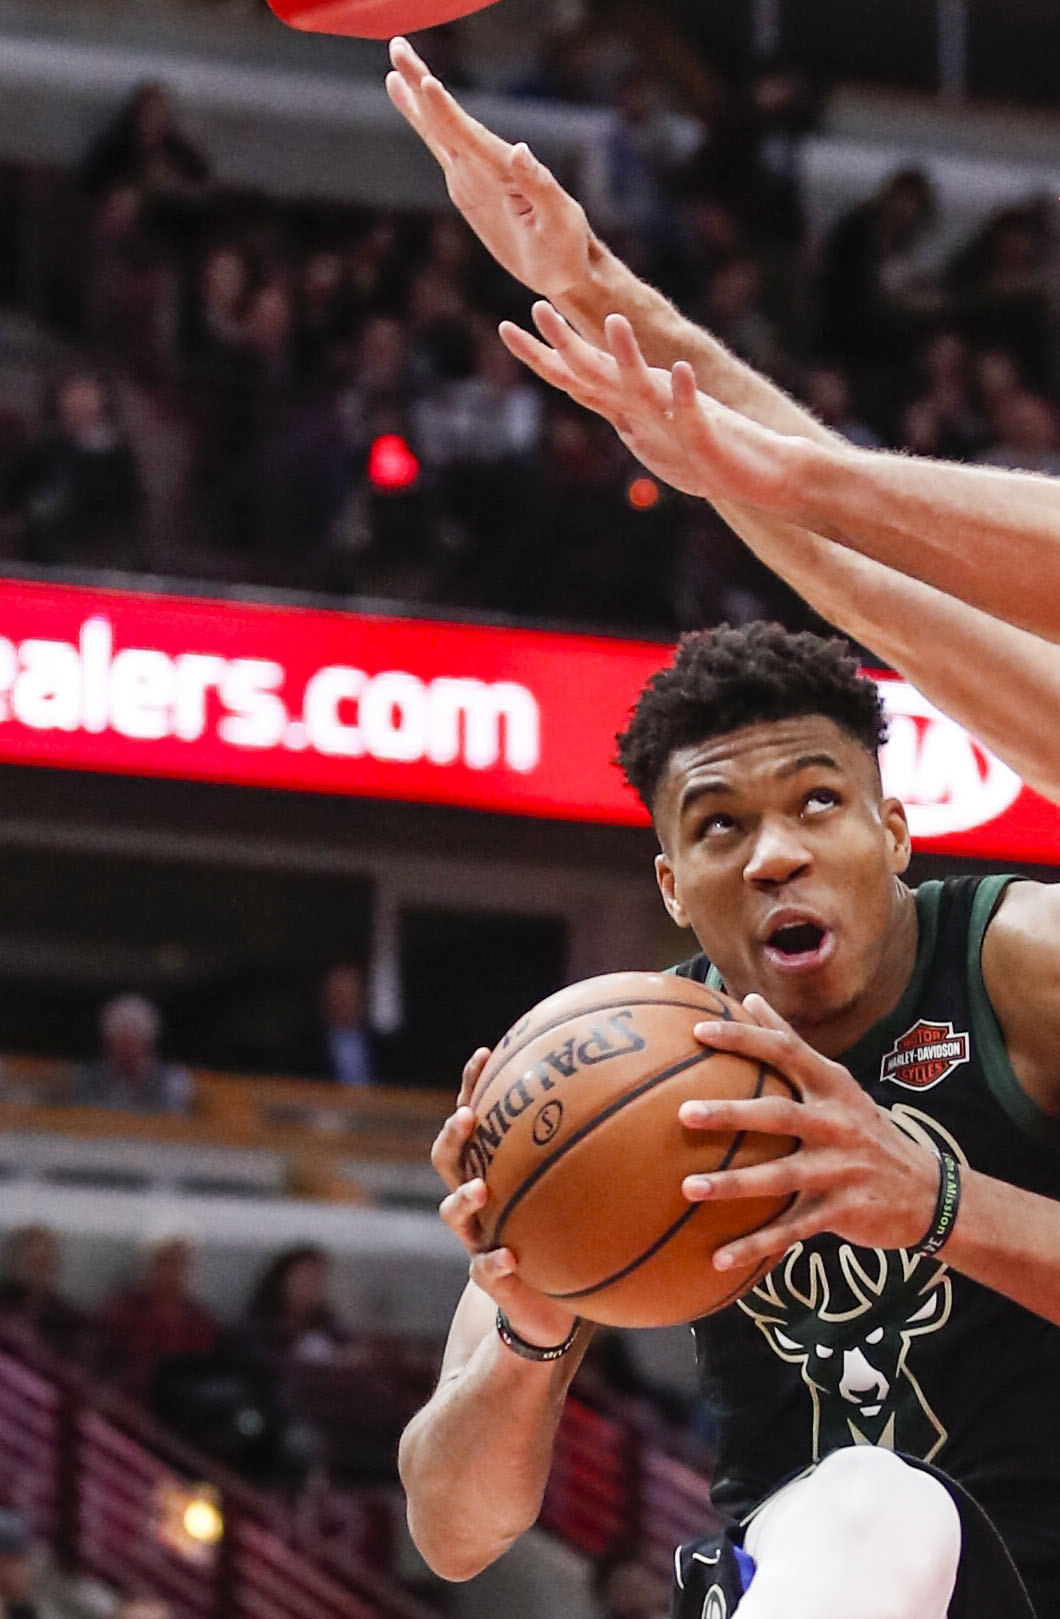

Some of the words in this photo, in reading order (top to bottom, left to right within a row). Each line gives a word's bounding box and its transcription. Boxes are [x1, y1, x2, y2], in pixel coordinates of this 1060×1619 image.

[0, 617, 540, 773] alers.com
[459, 1011, 646, 1184] SPALDING
[888, 1041, 961, 1072] HARLEY-DAVIDSON
[936, 1181, 957, 1235] Mission
